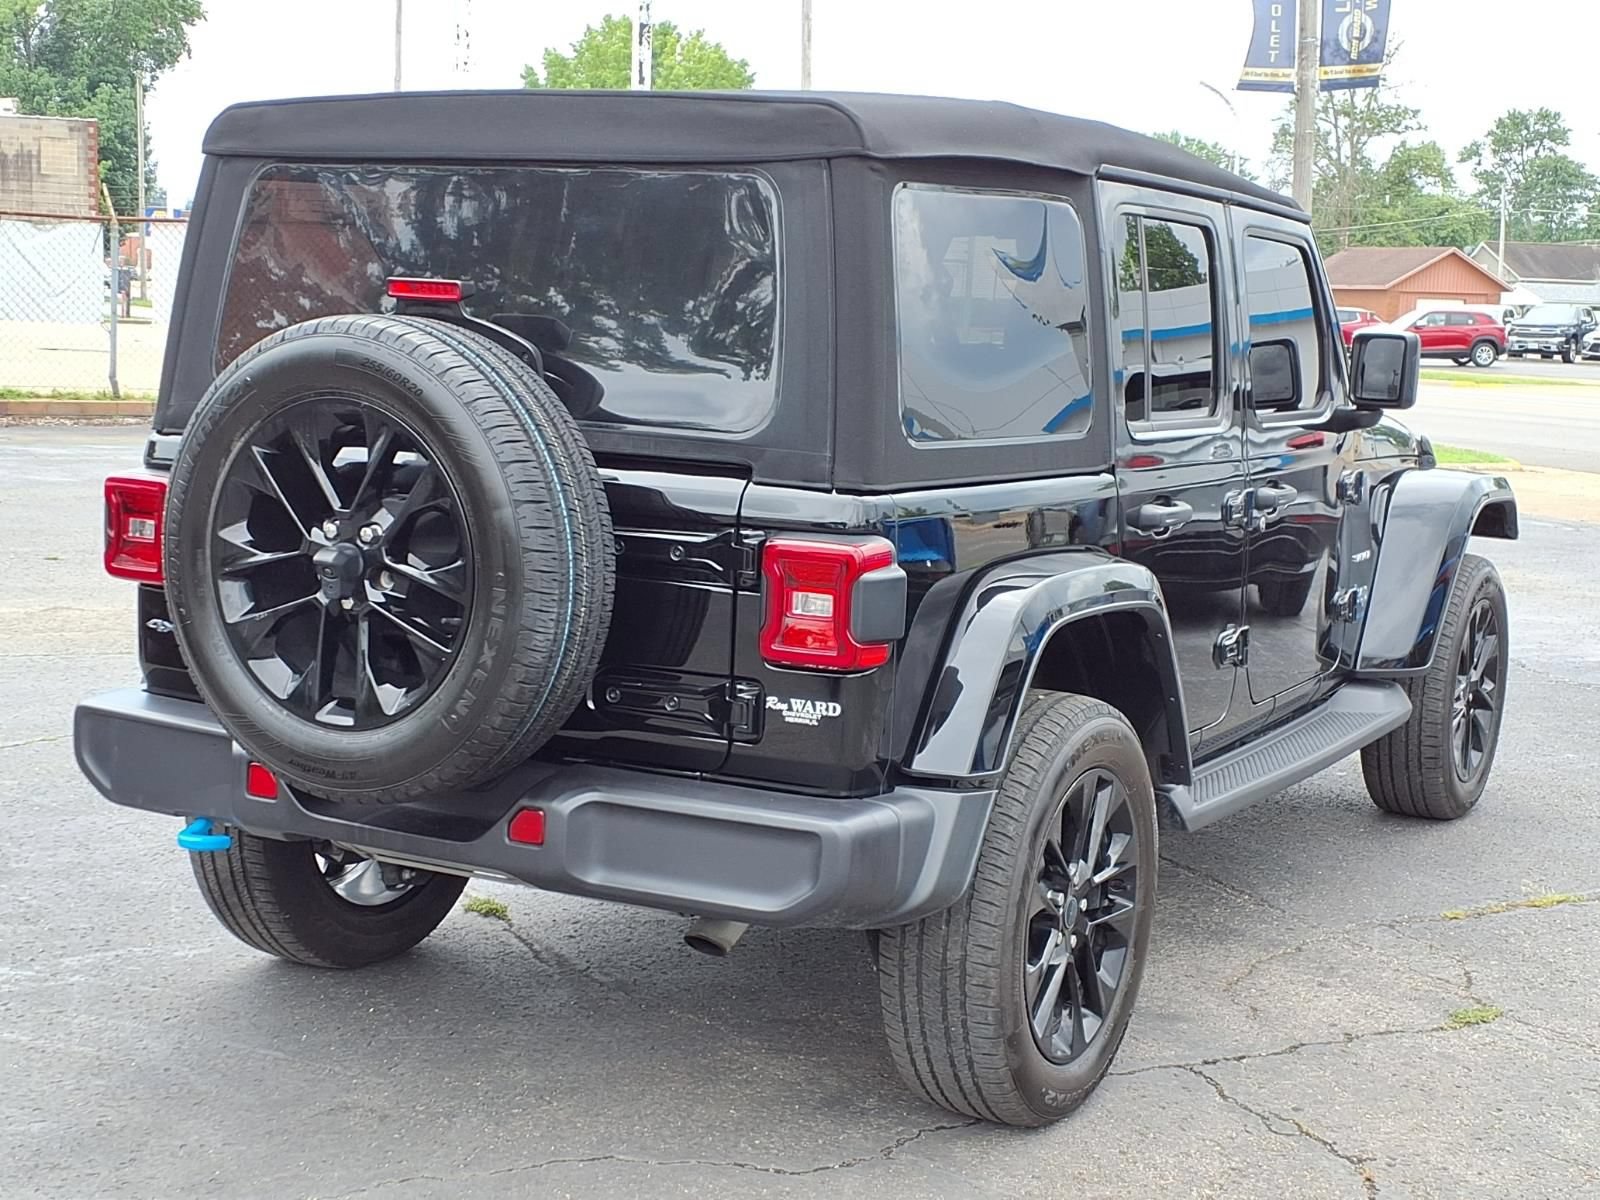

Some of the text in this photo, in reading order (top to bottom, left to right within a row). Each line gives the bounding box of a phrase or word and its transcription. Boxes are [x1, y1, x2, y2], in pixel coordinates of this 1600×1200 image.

[360, 358, 424, 397] 255/60R20
[455, 587, 507, 716] NEXEN
[790, 698, 841, 717] WARD
